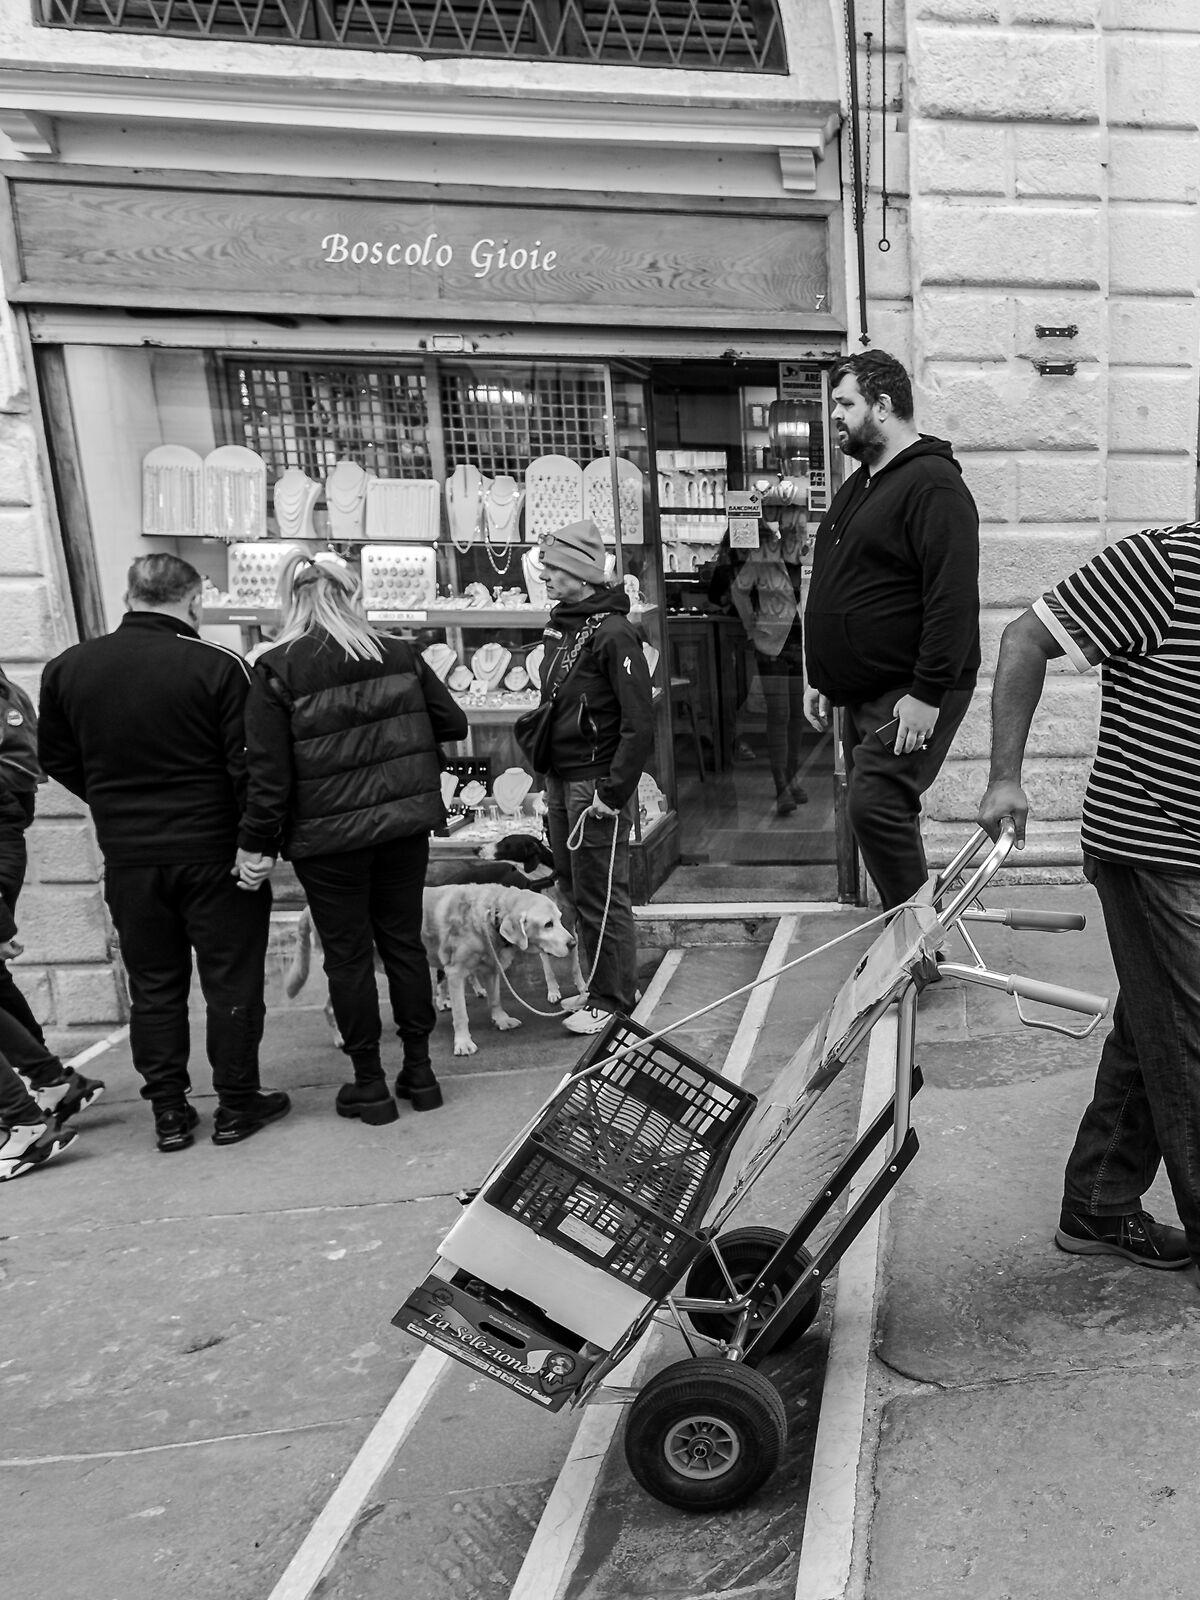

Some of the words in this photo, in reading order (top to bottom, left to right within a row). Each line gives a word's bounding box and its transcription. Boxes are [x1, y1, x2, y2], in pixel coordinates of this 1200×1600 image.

[321, 233, 453, 267] Boscolo
[470, 238, 557, 278] Gioie
[815, 294, 825, 310] 7
[424, 1312, 452, 1332] La
[450, 1325, 531, 1374] Selezione
